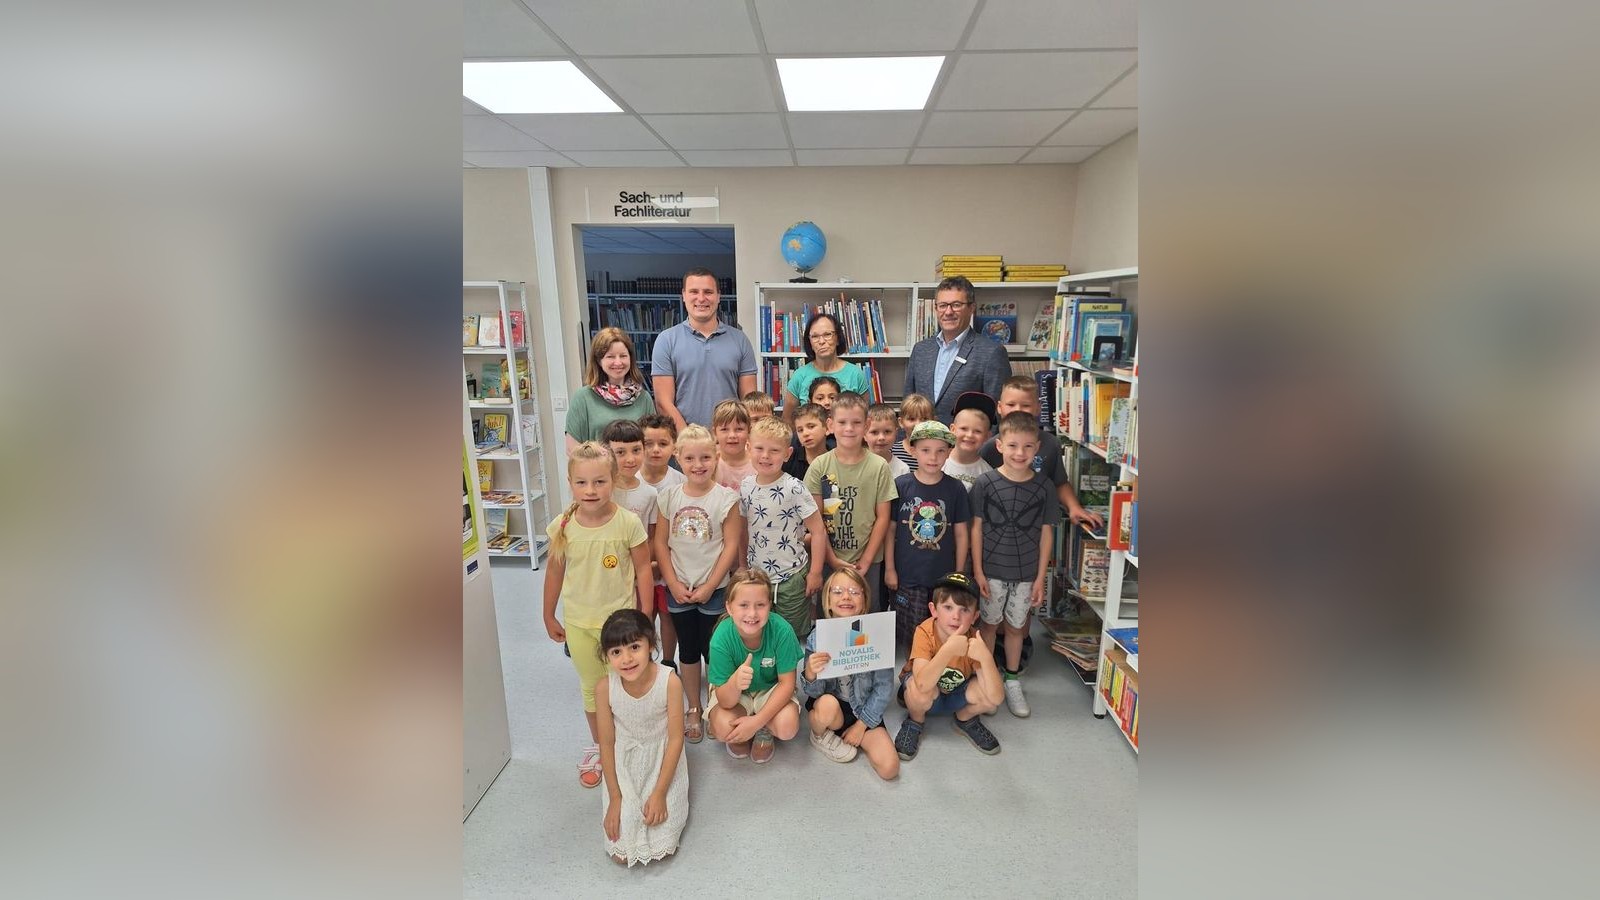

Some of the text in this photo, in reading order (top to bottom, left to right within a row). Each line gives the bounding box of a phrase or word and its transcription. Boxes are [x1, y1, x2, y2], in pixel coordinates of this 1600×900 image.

[619, 191, 684, 203] Sach- und
[614, 205, 691, 217] Fachliteratur
[838, 485, 859, 498] LETS
[838, 498, 855, 511] GO
[839, 512, 853, 525] TO
[837, 526, 855, 540] THE
[840, 646, 875, 658] NOVALIS
[832, 653, 880, 666] BIBLIOTHEK
[844, 662, 870, 671] ARTERN
